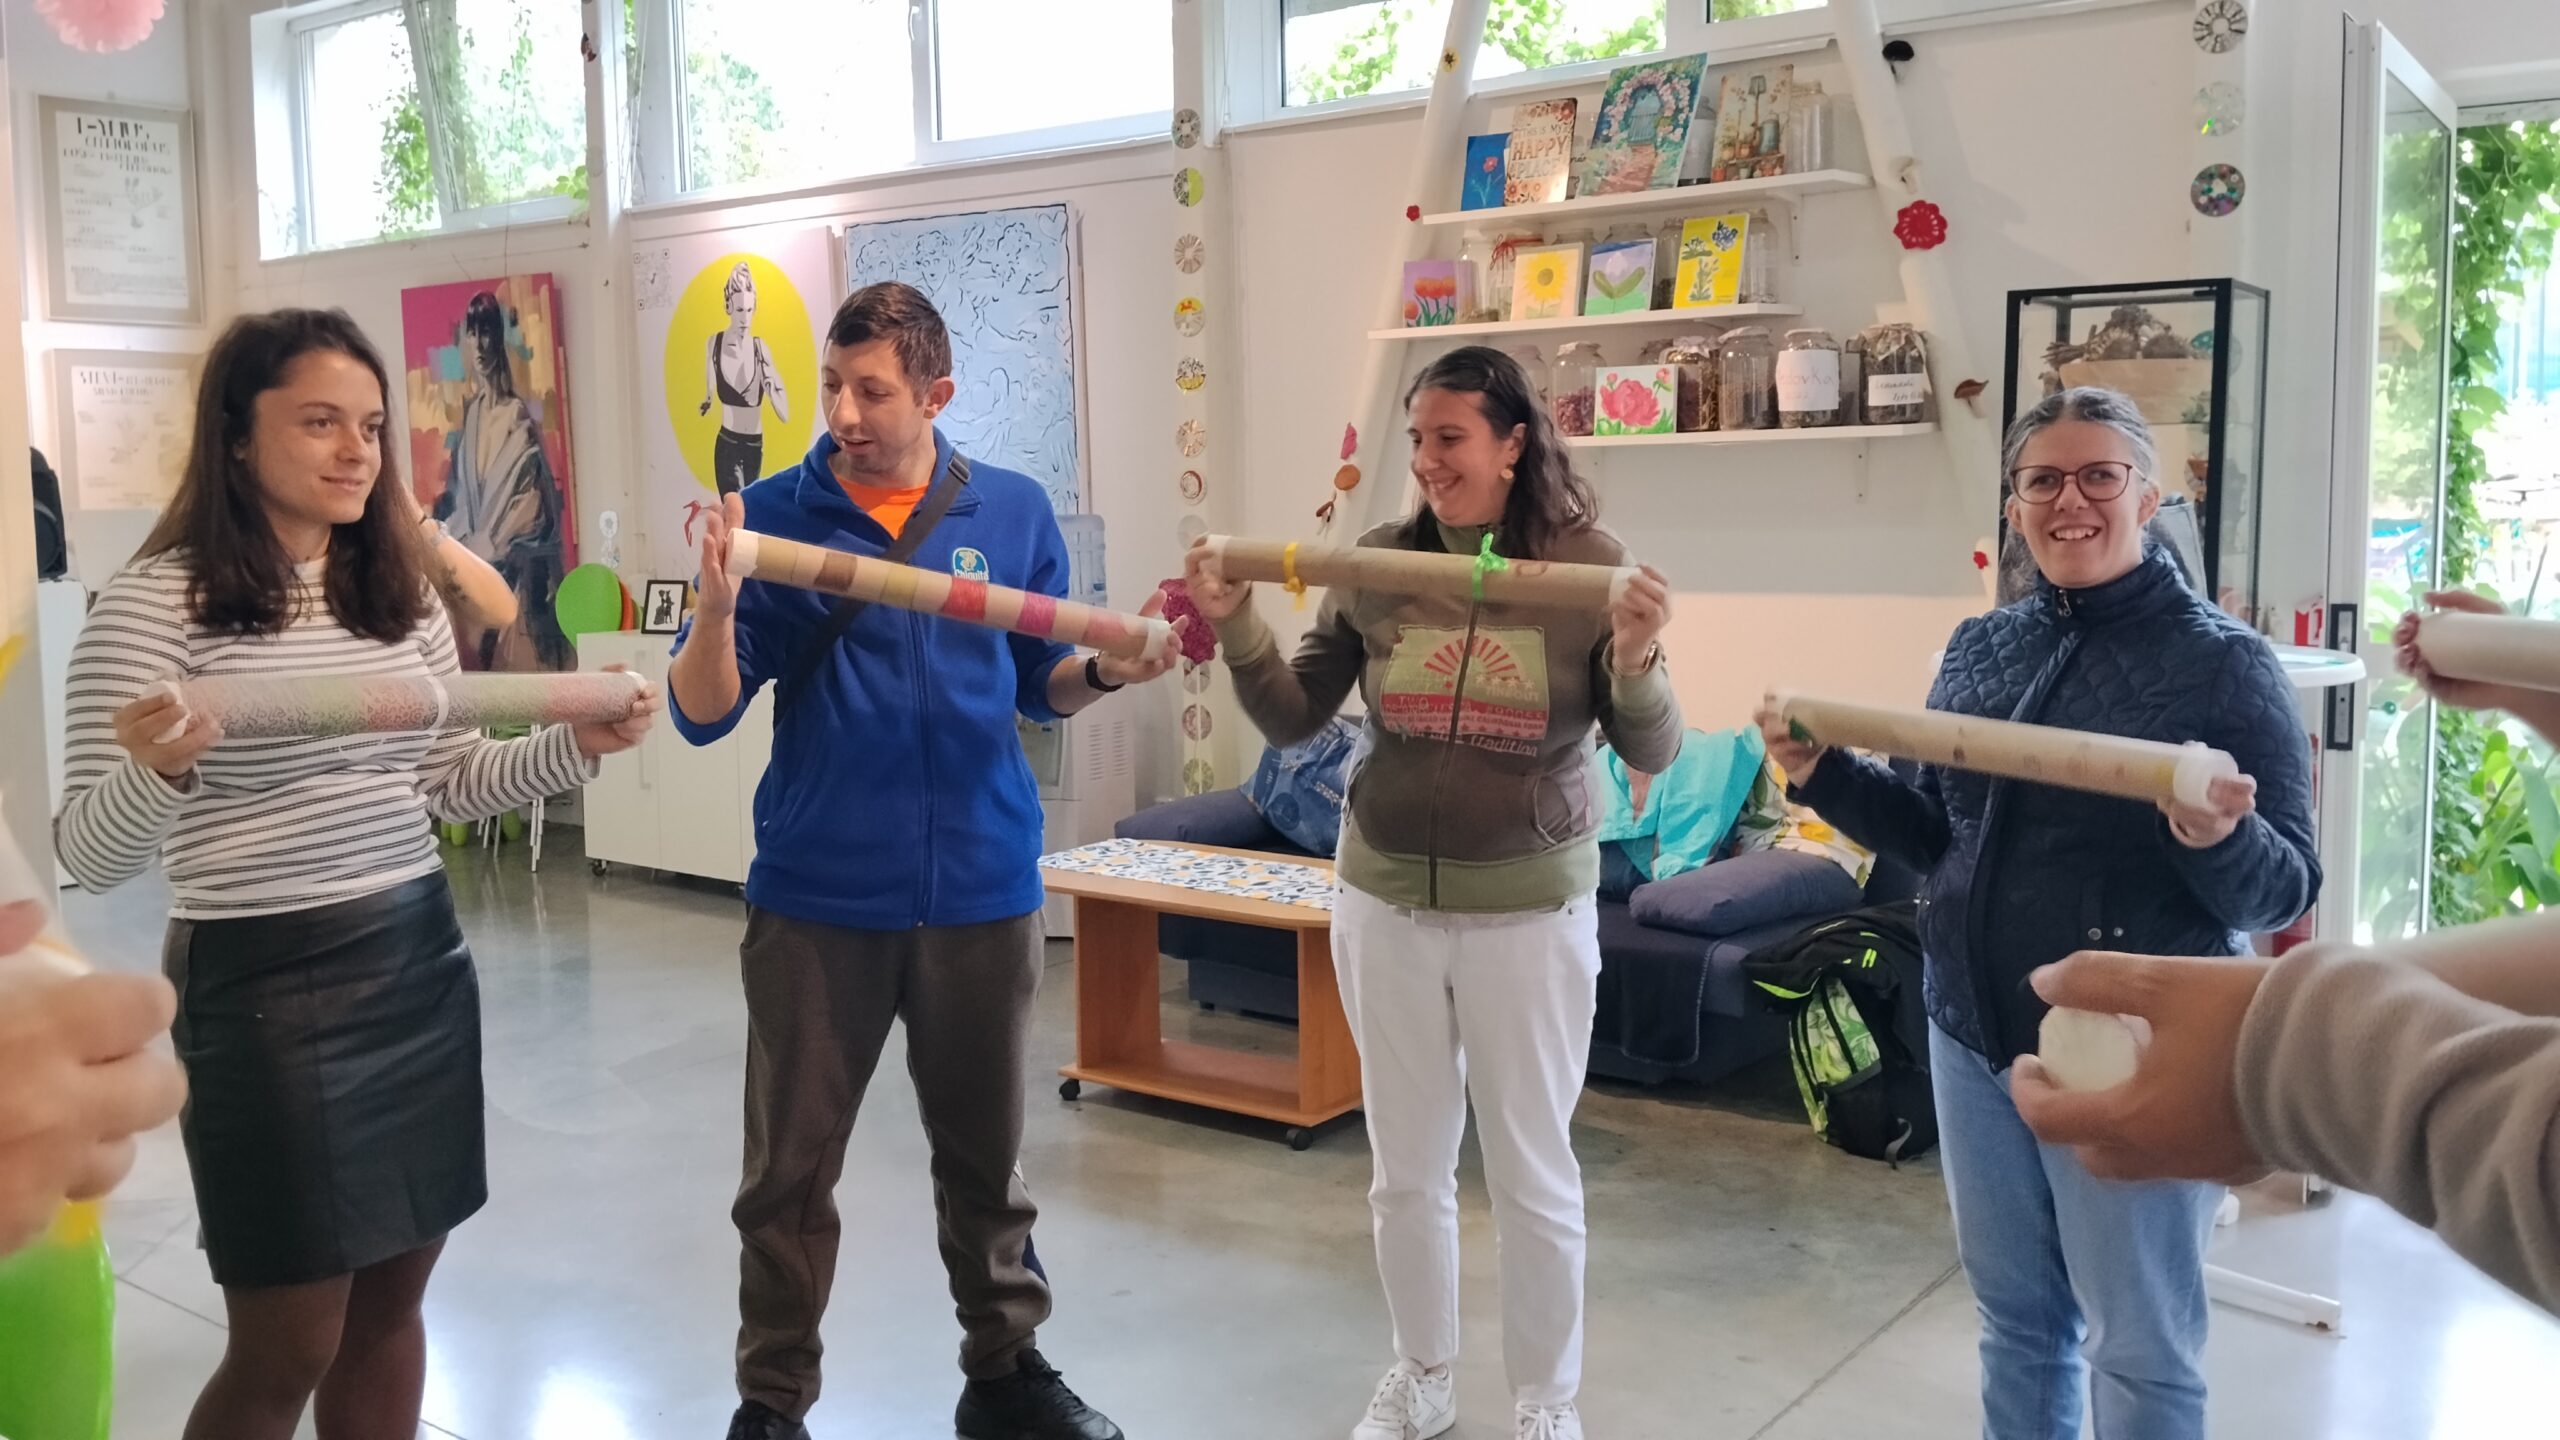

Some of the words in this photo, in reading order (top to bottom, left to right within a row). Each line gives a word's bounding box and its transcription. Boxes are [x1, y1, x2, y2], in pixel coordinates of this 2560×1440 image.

[1511, 135, 1568, 161] HAPPY
[1508, 157, 1561, 179] PLACE
[1470, 735, 1538, 757] tradition
